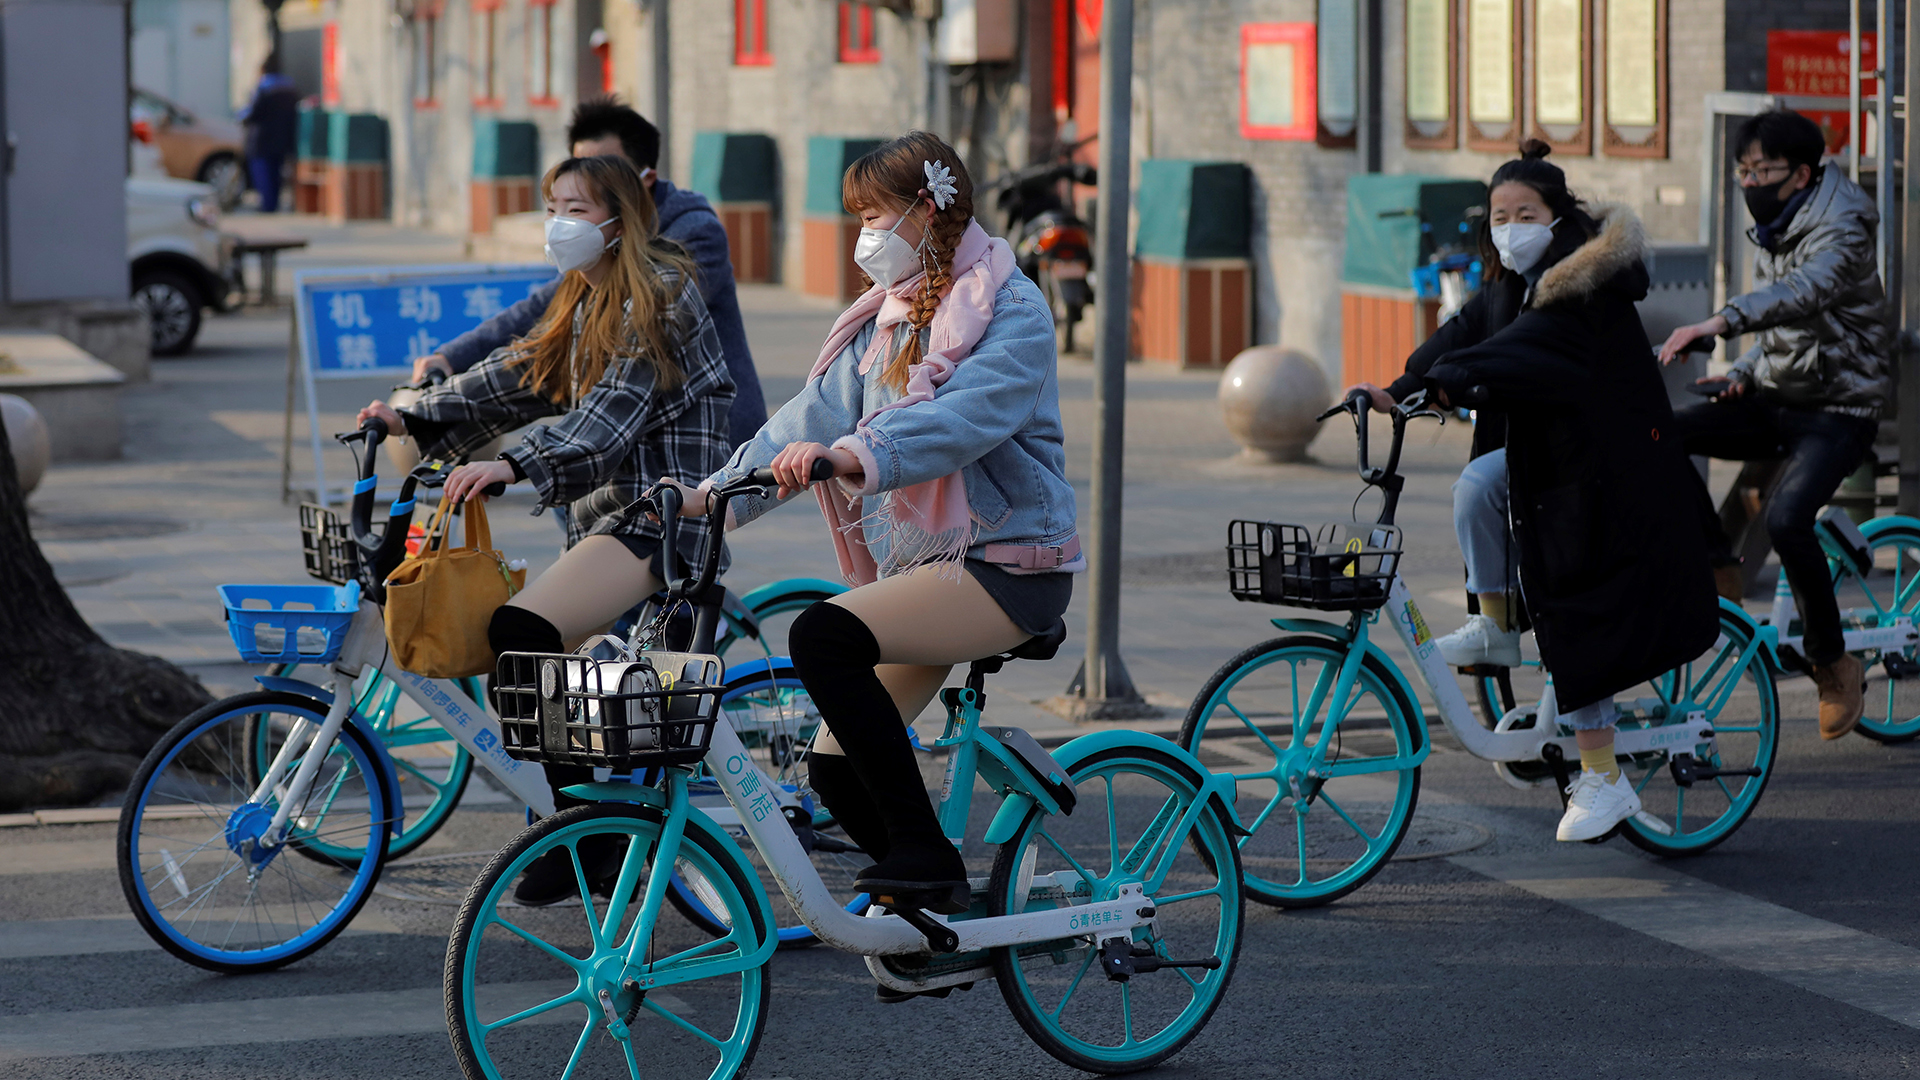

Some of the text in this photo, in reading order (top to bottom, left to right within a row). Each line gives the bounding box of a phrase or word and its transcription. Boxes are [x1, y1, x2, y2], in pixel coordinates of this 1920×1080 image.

[328, 282, 546, 329] 机动车
[420, 679, 473, 729] 哈啰单车
[736, 769, 774, 823] 青桔
[1080, 909, 1123, 928] 青桔单车
